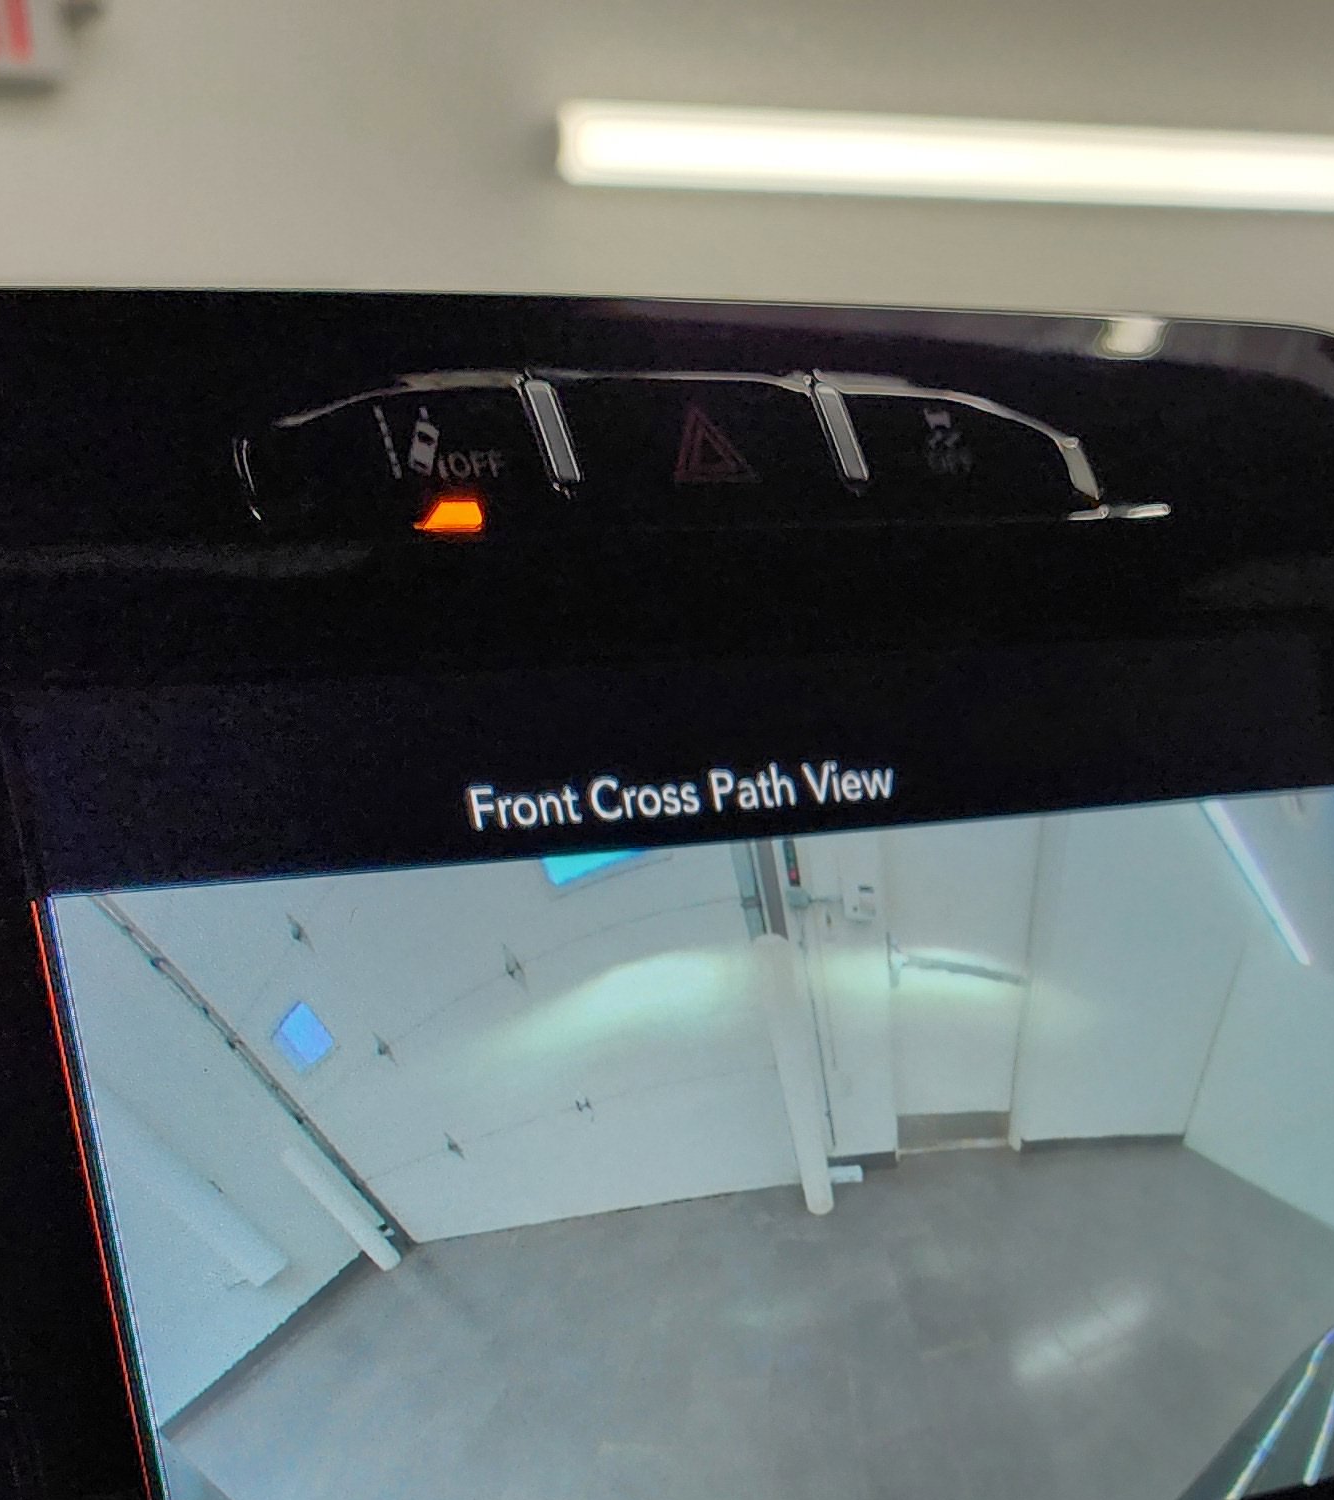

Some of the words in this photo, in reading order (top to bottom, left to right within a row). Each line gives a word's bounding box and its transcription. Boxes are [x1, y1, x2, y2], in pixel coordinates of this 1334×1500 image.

[446, 449, 504, 480] OFF
[466, 783, 584, 832] Front
[586, 773, 702, 823] Cross
[707, 760, 799, 813] Path
[799, 758, 896, 806] View
